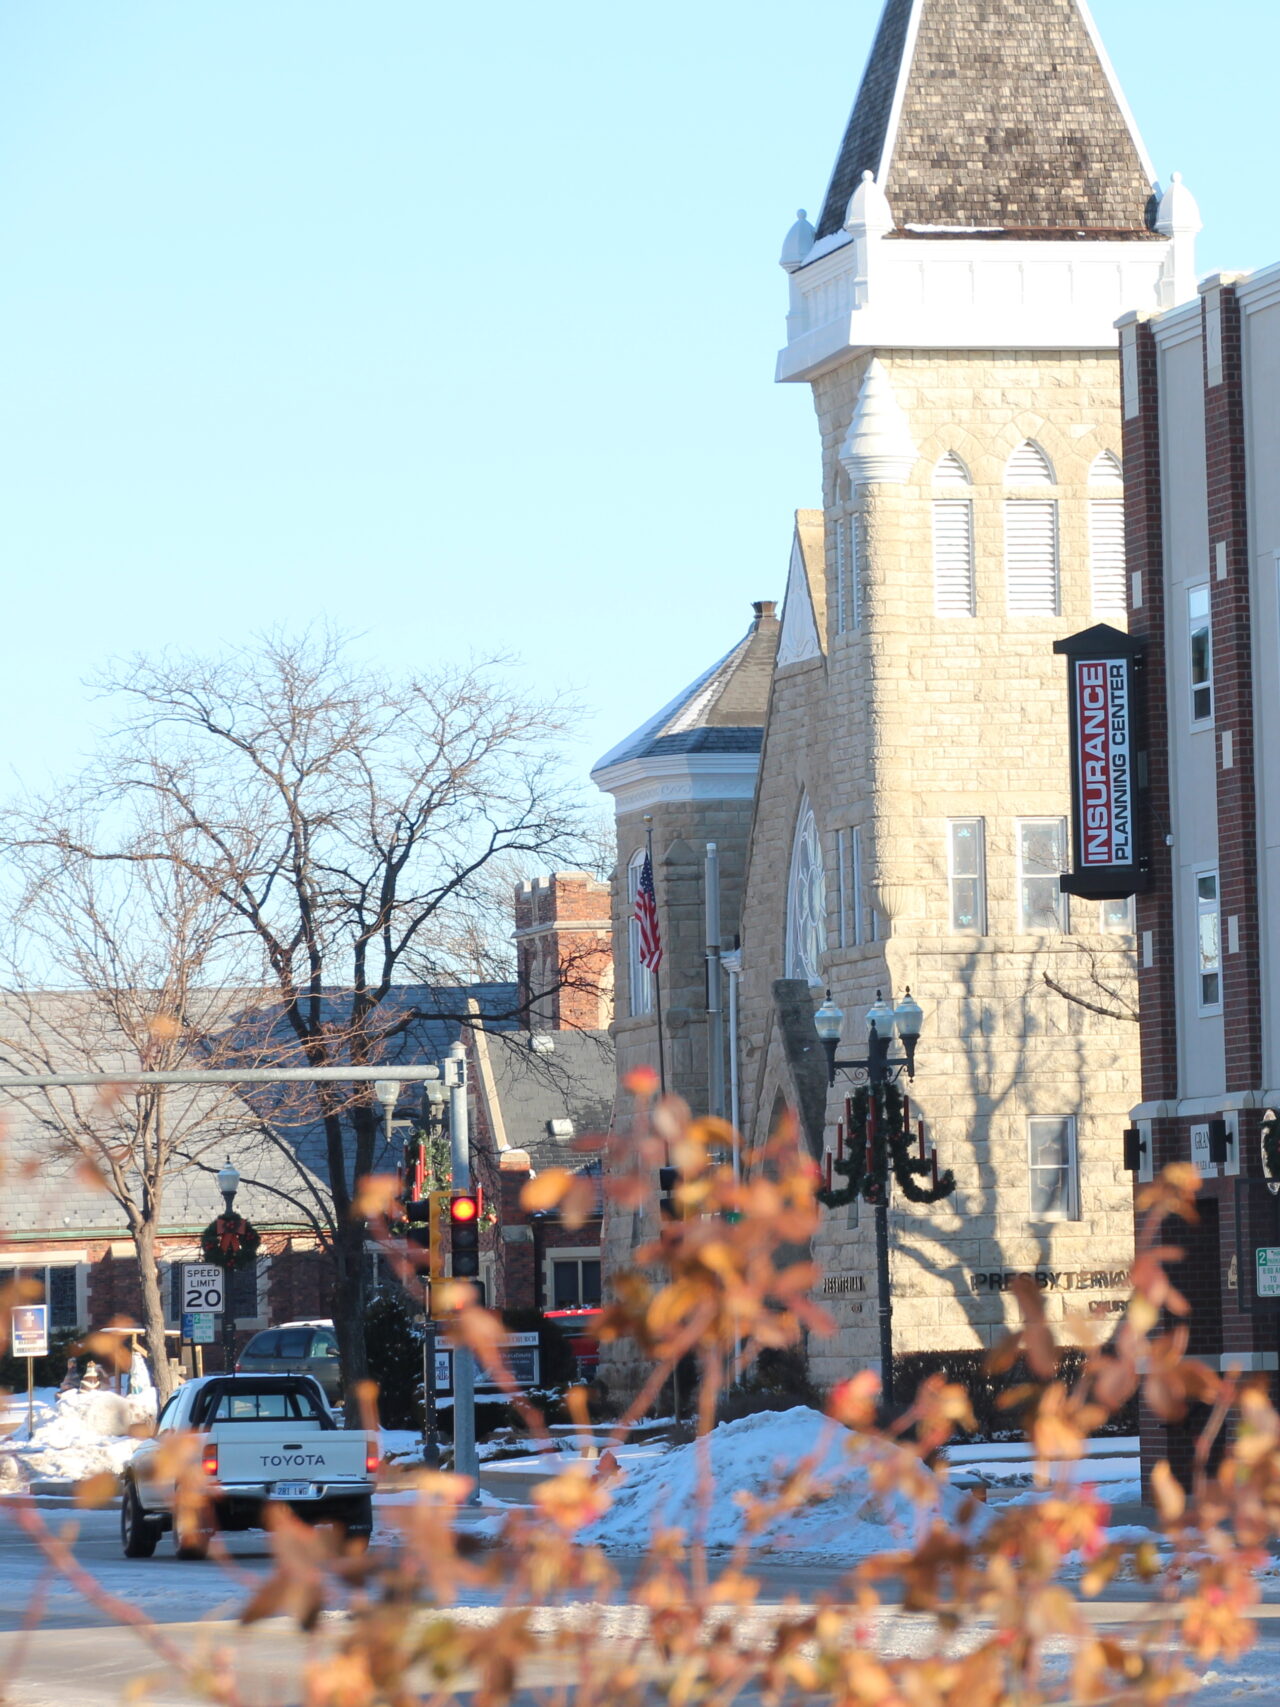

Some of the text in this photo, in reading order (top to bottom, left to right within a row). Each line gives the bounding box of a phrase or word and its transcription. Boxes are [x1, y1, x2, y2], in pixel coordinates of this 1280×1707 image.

[1082, 665, 1108, 861] INSURANCE
[1109, 664, 1128, 861] PLANNING CENTER
[1258, 1251, 1266, 1264] 2
[186, 1269, 221, 1278] SPEED
[1269, 1275, 1277, 1283] TO
[190, 1279, 217, 1288] LIMIT
[971, 1270, 1133, 1292] PREBYTERIA
[186, 1289, 222, 1308] 20
[1088, 1300, 1129, 1313] CURC
[260, 1454, 326, 1466] TOYOTA
